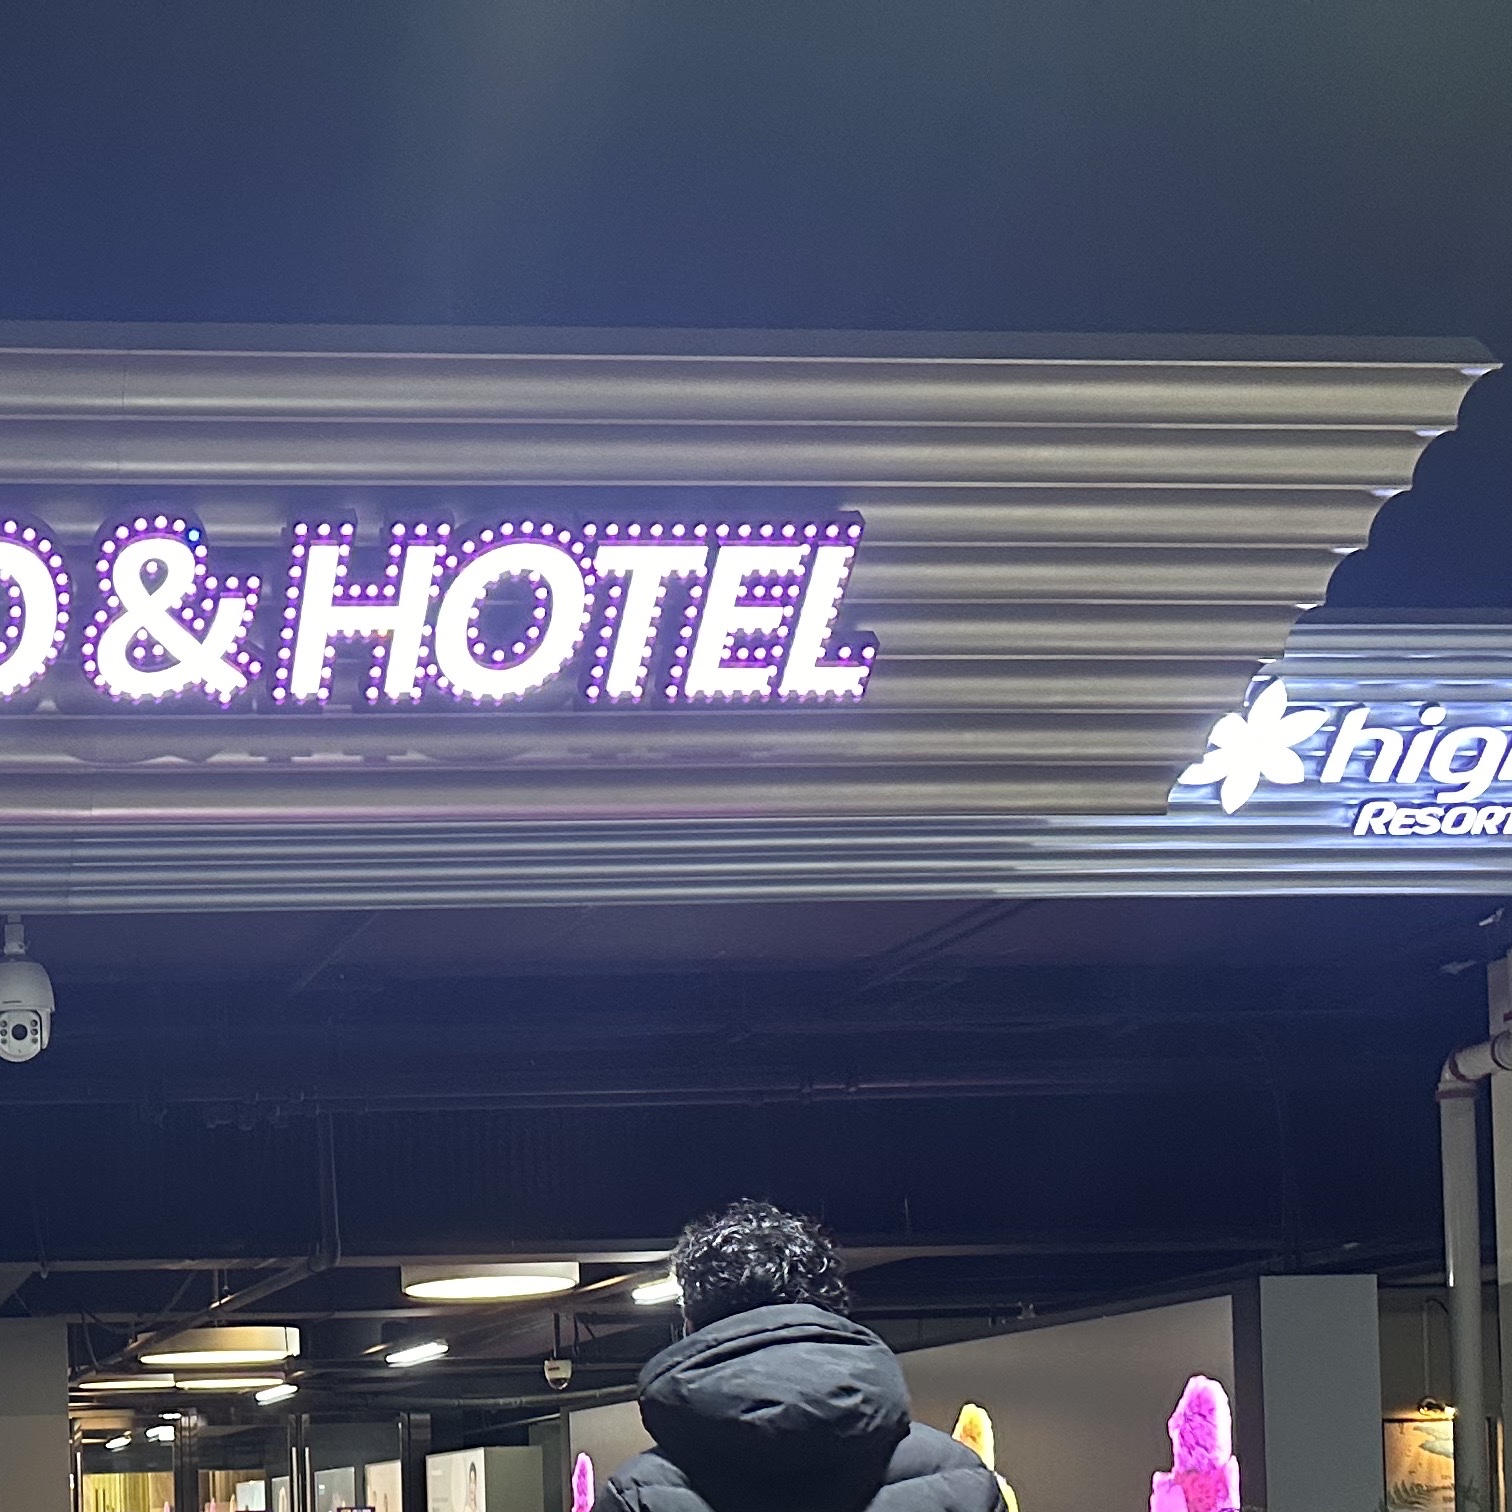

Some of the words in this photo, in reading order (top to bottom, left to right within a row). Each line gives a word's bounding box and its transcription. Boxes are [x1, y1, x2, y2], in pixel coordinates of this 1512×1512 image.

[86, 518, 260, 703] &
[274, 520, 880, 704] HOTEL
[1319, 704, 1512, 805] hig
